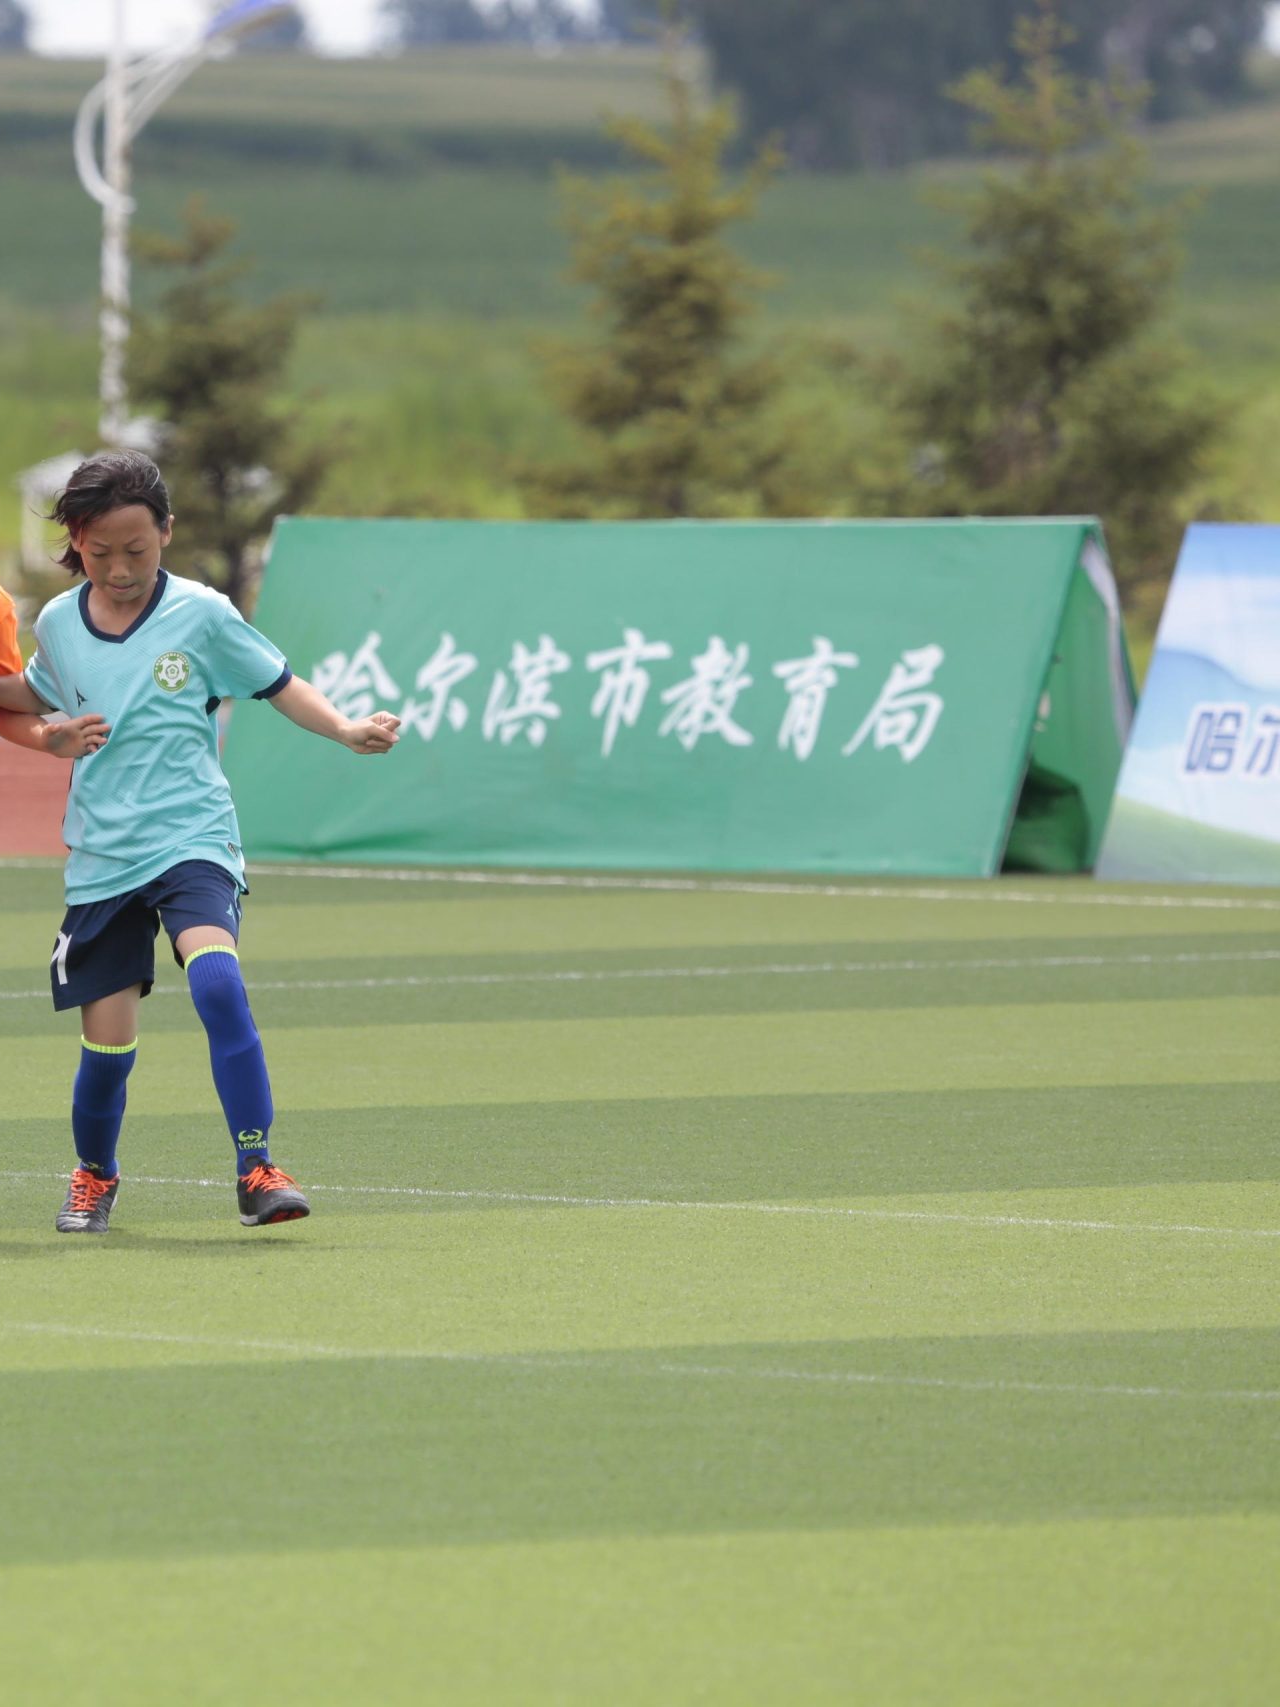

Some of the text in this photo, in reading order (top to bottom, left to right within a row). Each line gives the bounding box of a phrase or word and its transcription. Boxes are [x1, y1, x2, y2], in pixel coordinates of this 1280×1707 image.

[311, 628, 946, 763] 哈尔滨市教育局
[238, 1140, 267, 1150] LOOKS
